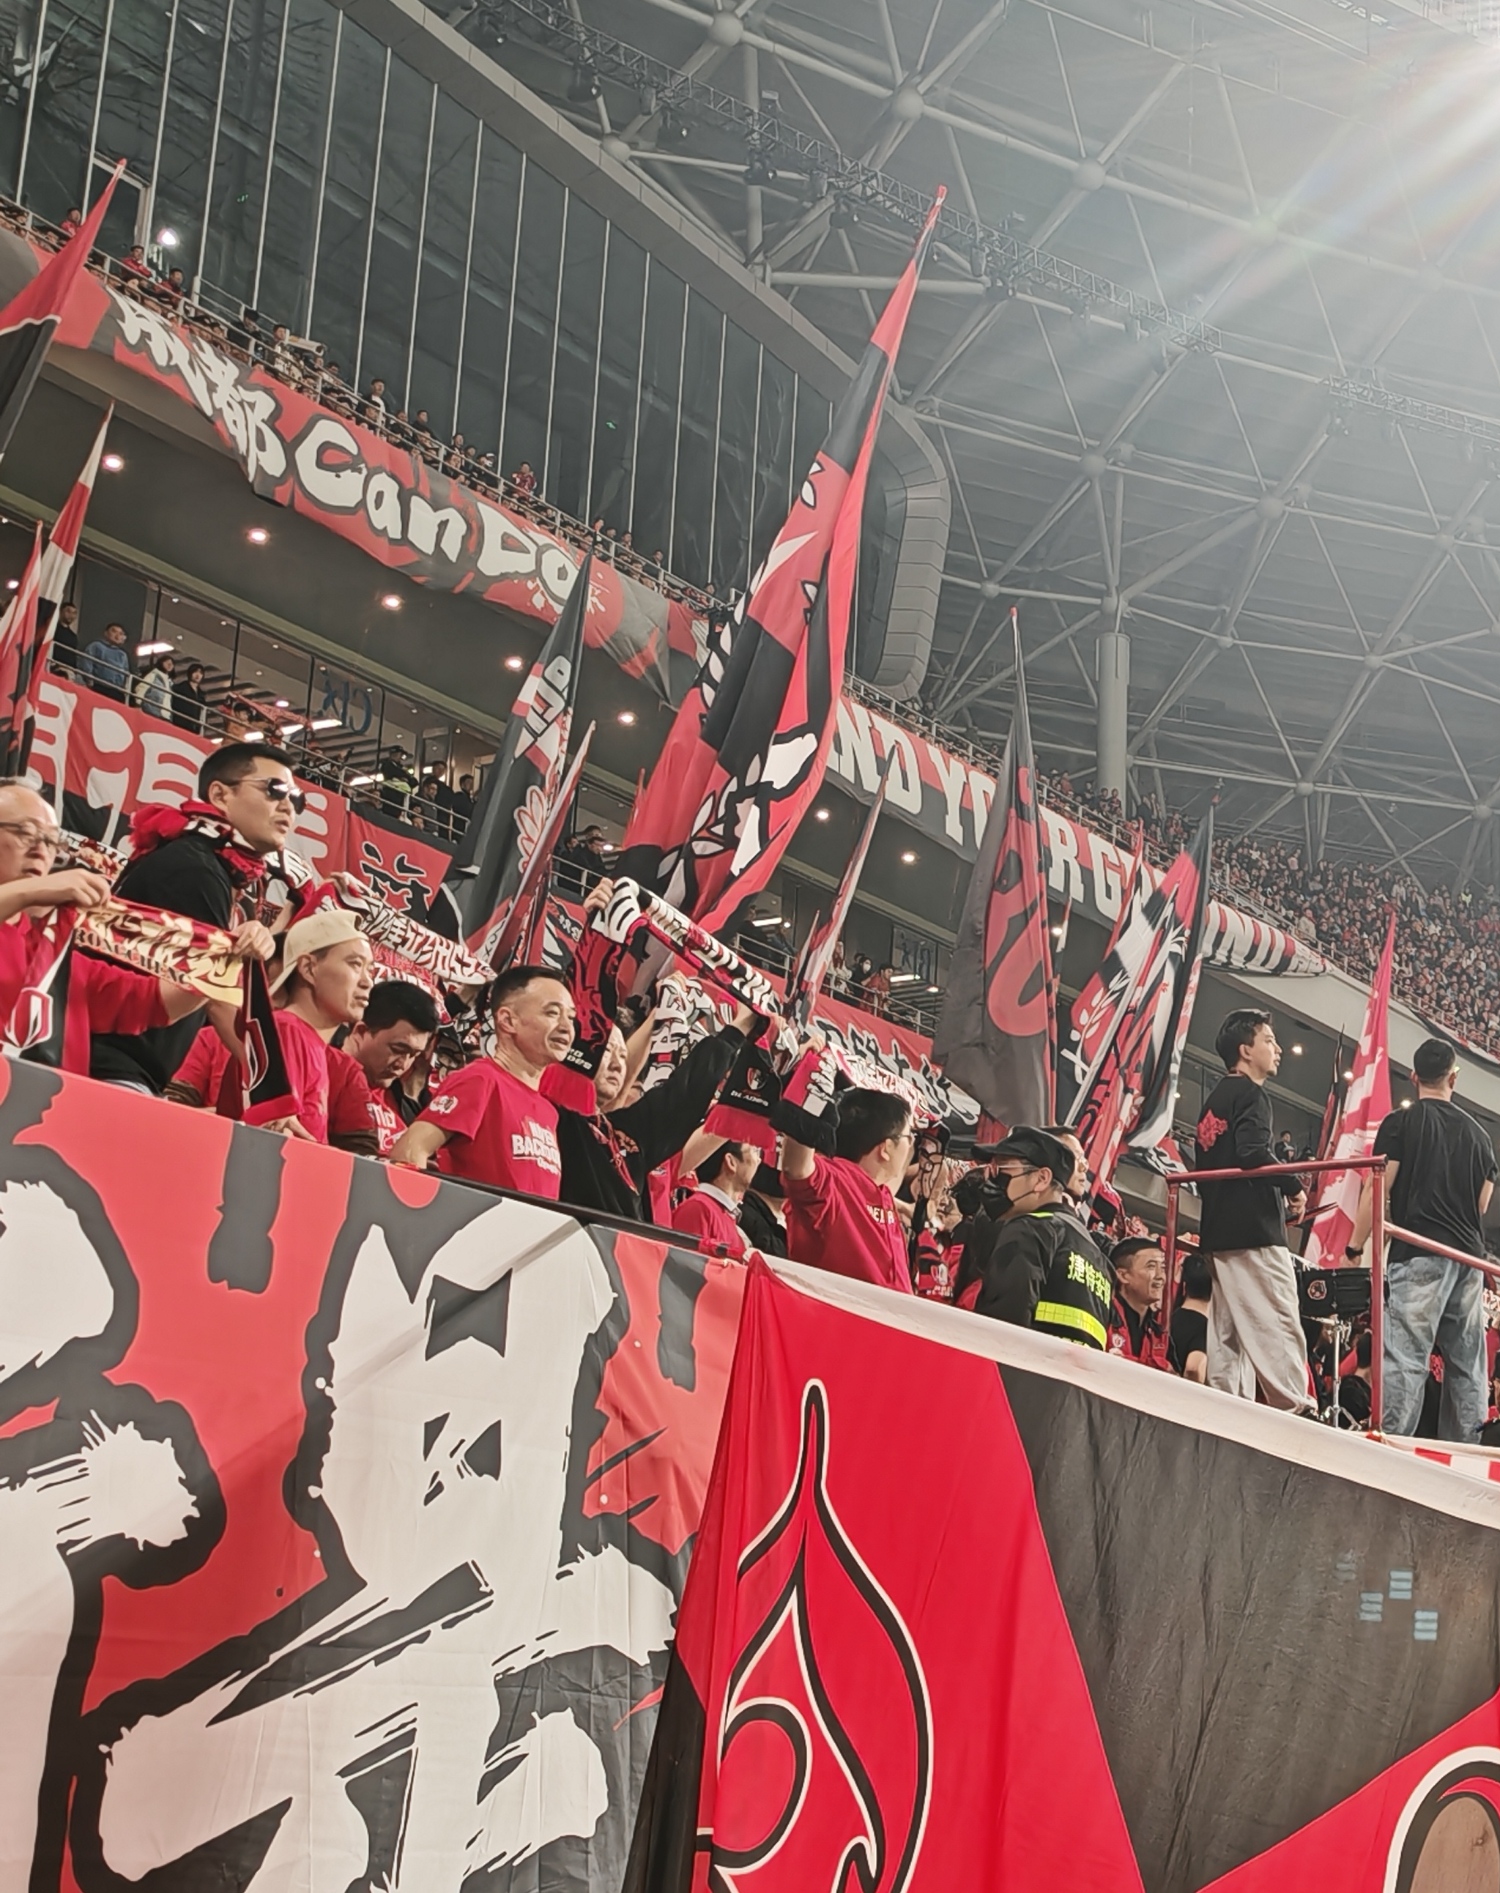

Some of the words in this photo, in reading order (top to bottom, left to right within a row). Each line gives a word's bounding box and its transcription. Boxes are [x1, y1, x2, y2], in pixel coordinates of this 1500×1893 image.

[295, 418, 469, 564] Can
[475, 501, 584, 602] Do
[928, 747, 1085, 903] YOR
